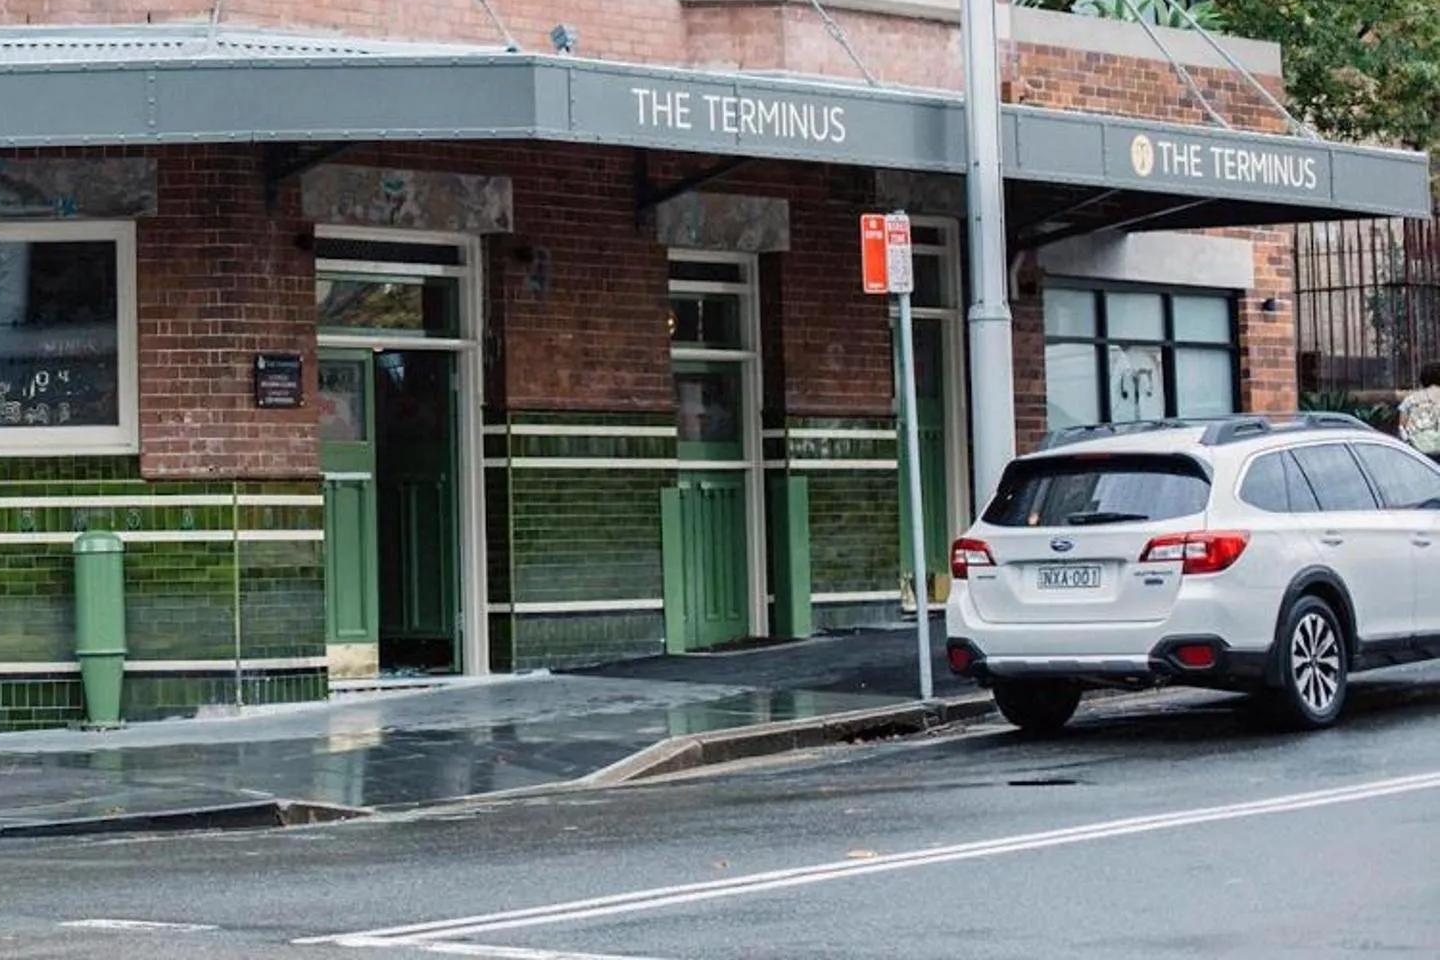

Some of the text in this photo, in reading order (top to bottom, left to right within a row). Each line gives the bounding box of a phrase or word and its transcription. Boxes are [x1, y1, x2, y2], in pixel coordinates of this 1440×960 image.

[631, 87, 846, 143] THE TERMINUS
[1158, 142, 1317, 190] THE TERMINUS
